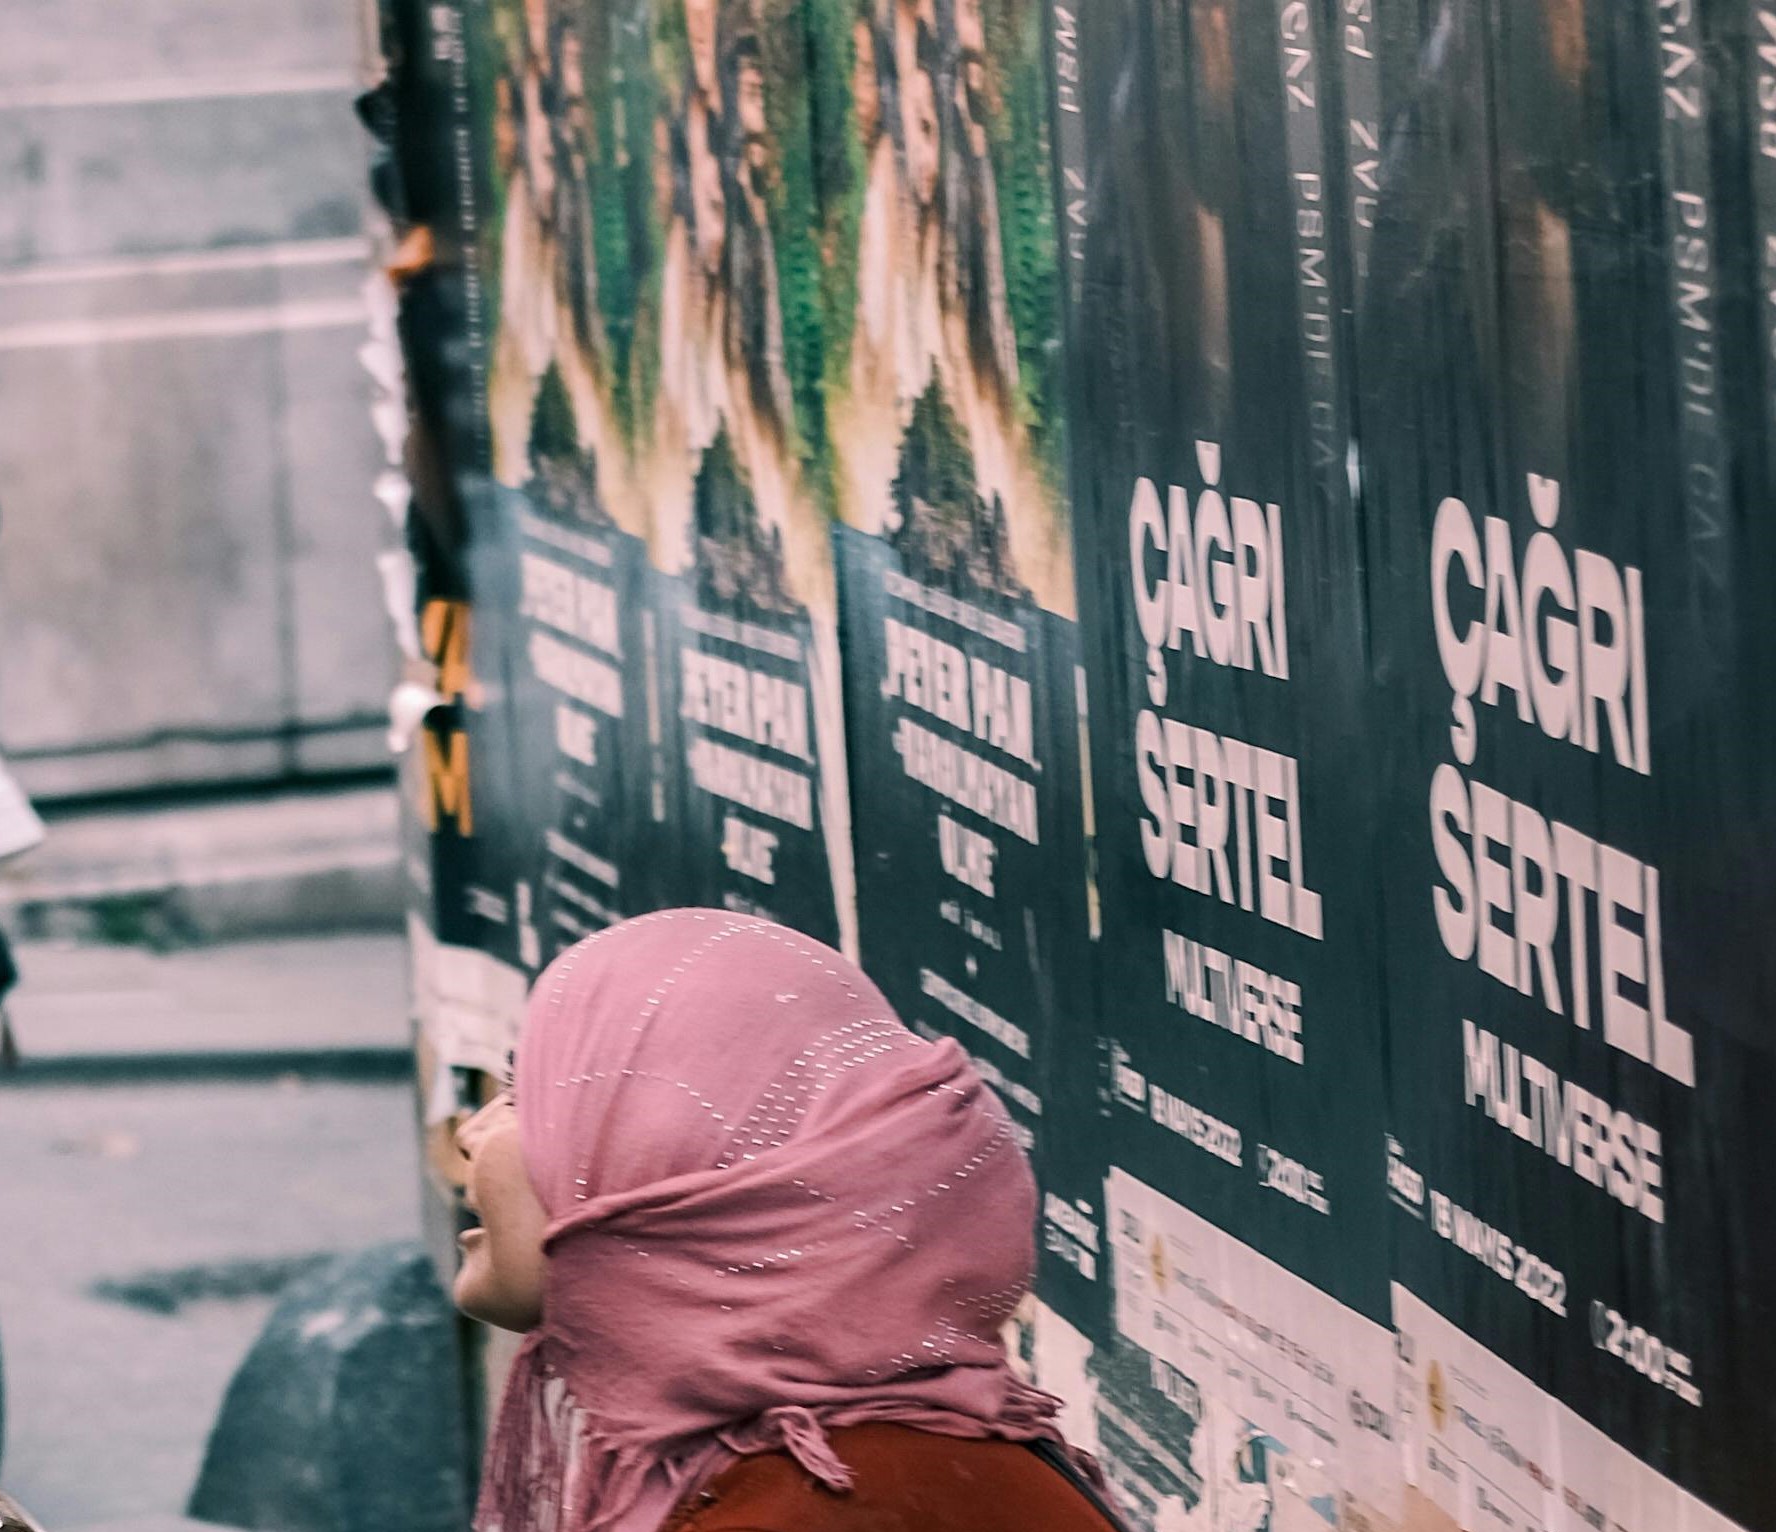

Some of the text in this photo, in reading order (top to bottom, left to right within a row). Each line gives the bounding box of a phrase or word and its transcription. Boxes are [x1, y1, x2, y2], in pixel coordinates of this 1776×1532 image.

[1129, 440, 1289, 705] ÇAĞRI
[1431, 472, 1651, 776] ÇAĞRI
[1136, 709, 1323, 941] SERTEL
[1430, 762, 1696, 1088] SERTEL
[1162, 928, 1304, 1066] MULTIVERSE
[1462, 1018, 1665, 1224] MULTIVERSE
